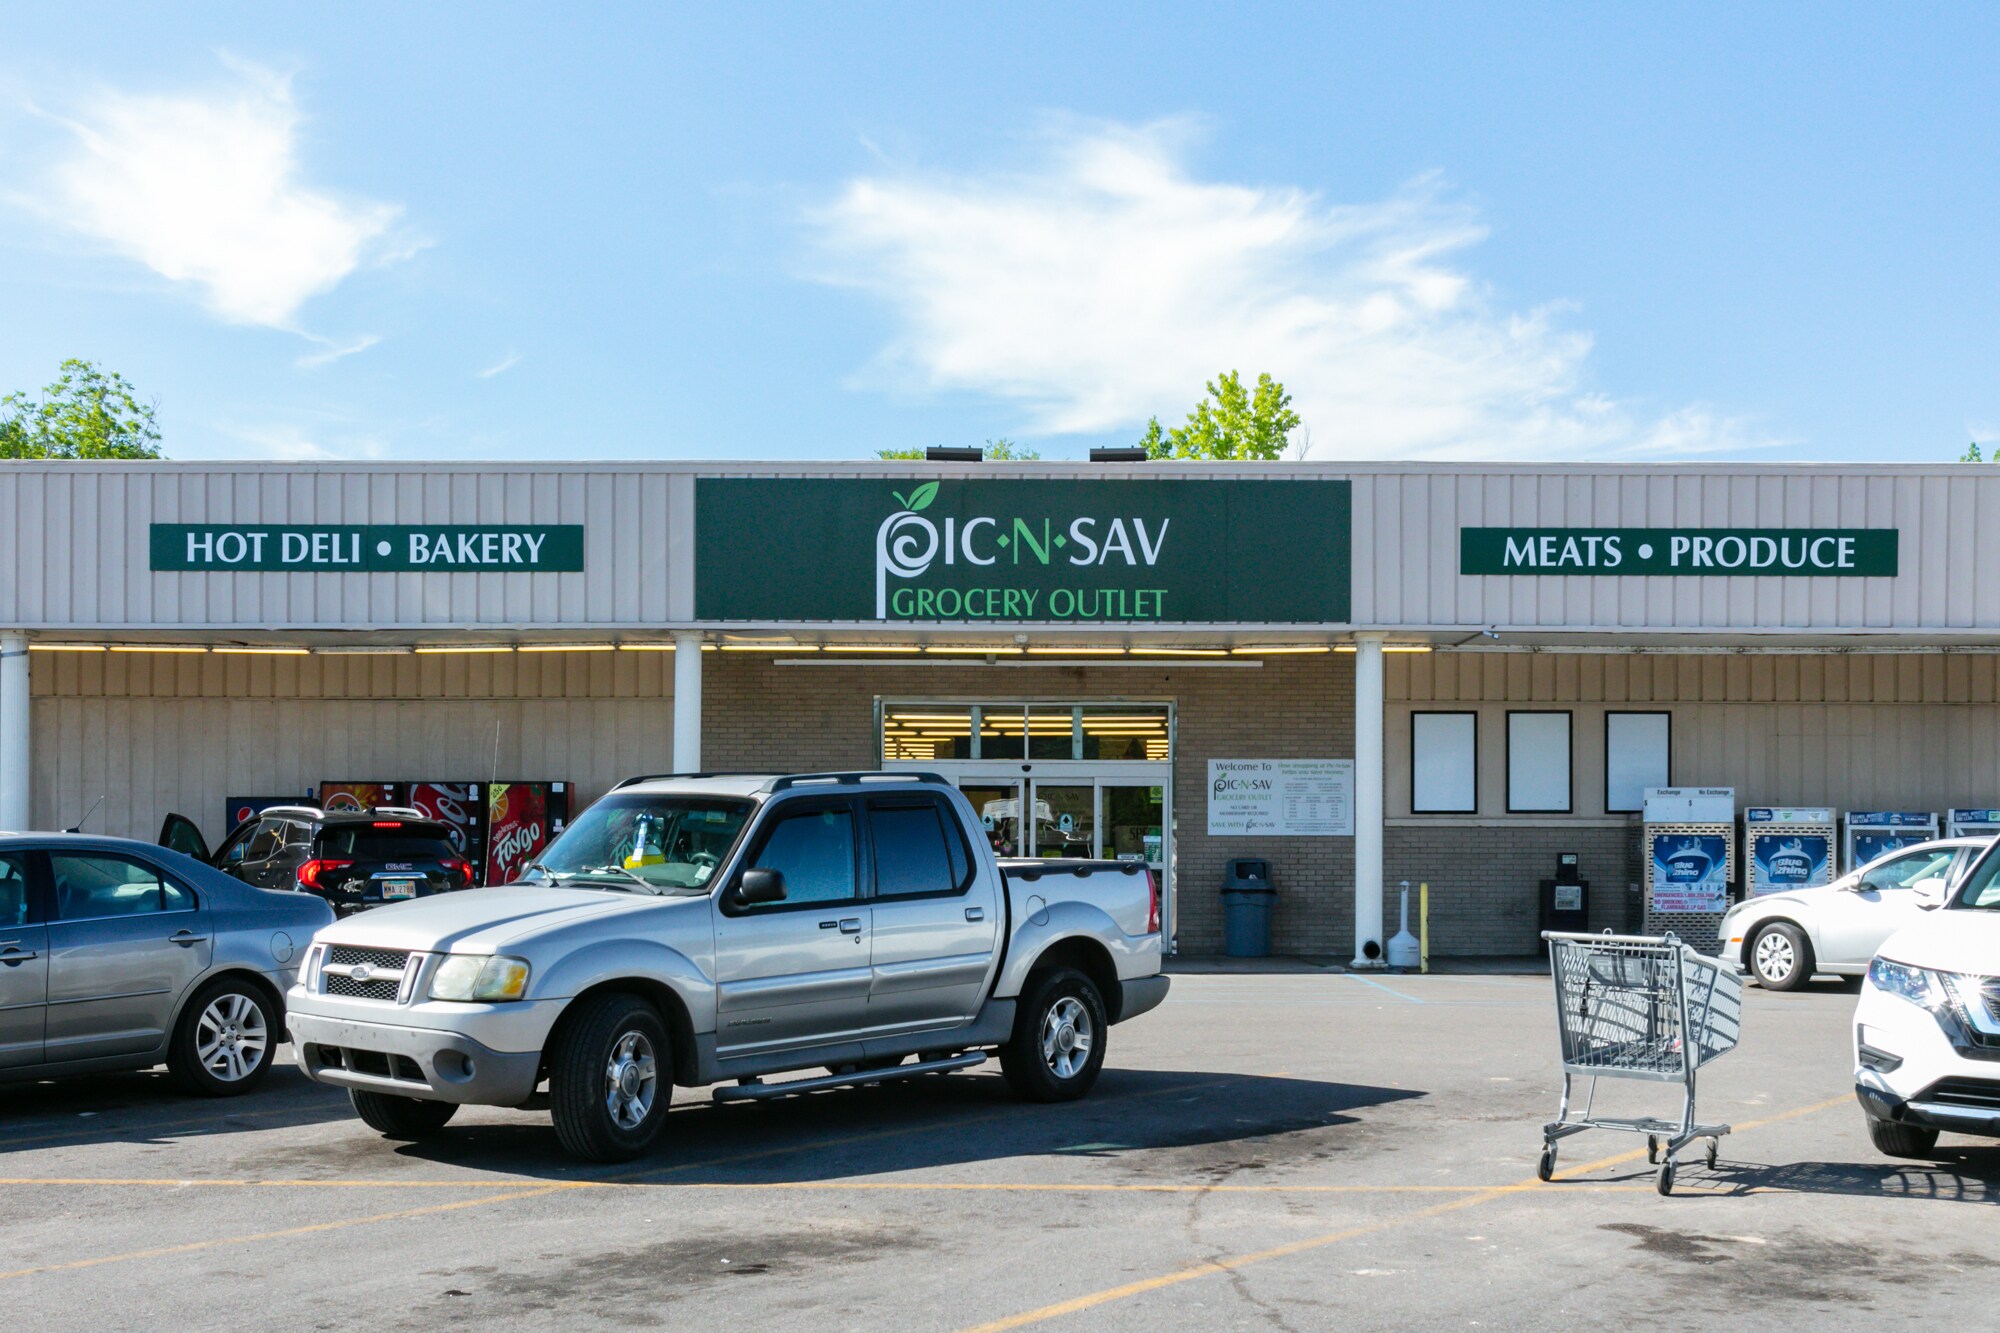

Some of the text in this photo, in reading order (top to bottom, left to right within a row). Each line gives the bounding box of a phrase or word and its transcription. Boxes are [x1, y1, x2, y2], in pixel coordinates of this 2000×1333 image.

[187, 532, 545, 564] HOT DELI BAKERY
[1503, 536, 1855, 568] MEATS PRODUCE
[892, 588, 1168, 617] GROCERY OUTLET
[1215, 762, 1272, 771] Welcome To
[492, 822, 540, 871] Faygo
